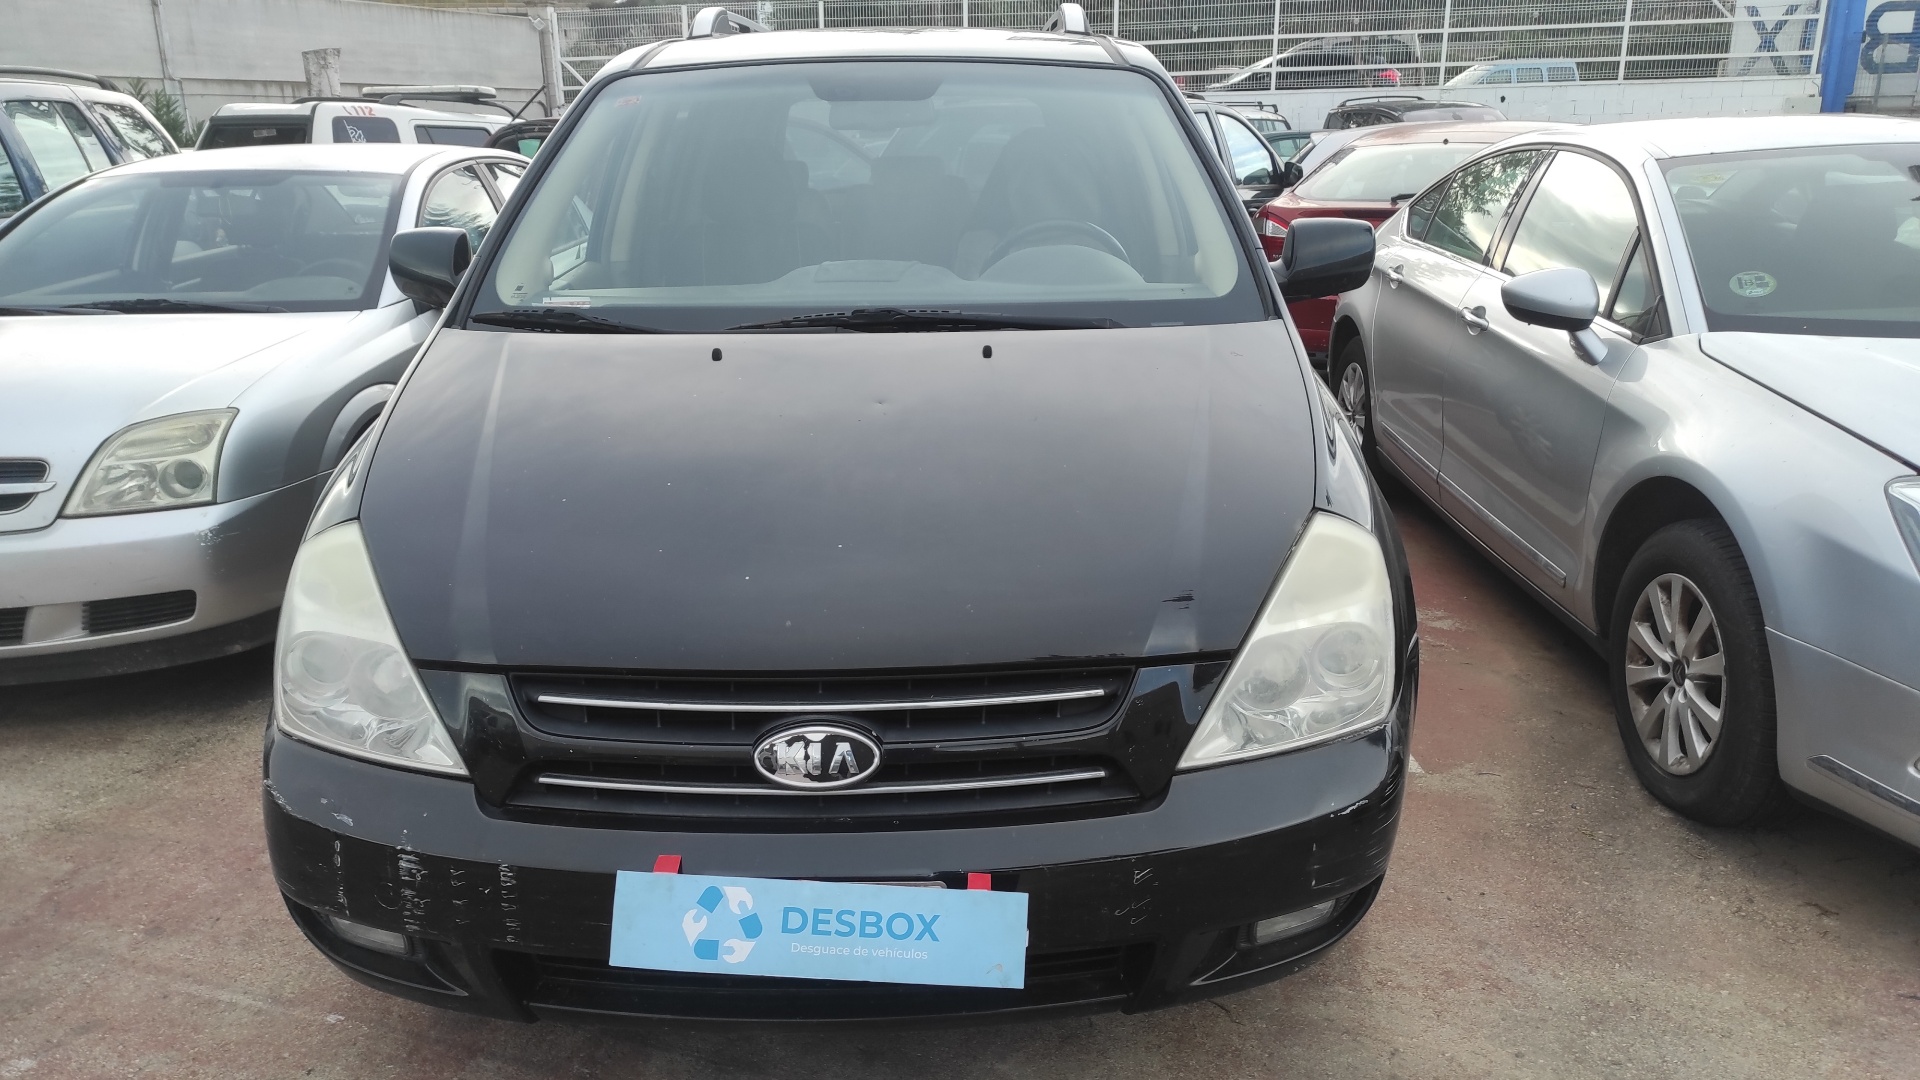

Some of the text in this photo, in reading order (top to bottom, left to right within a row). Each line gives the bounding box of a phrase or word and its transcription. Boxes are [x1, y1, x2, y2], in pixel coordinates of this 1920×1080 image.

[773, 741, 859, 775] KIA
[781, 906, 941, 942] DESBOX
[791, 942, 928, 960] Desguace de vehículos
